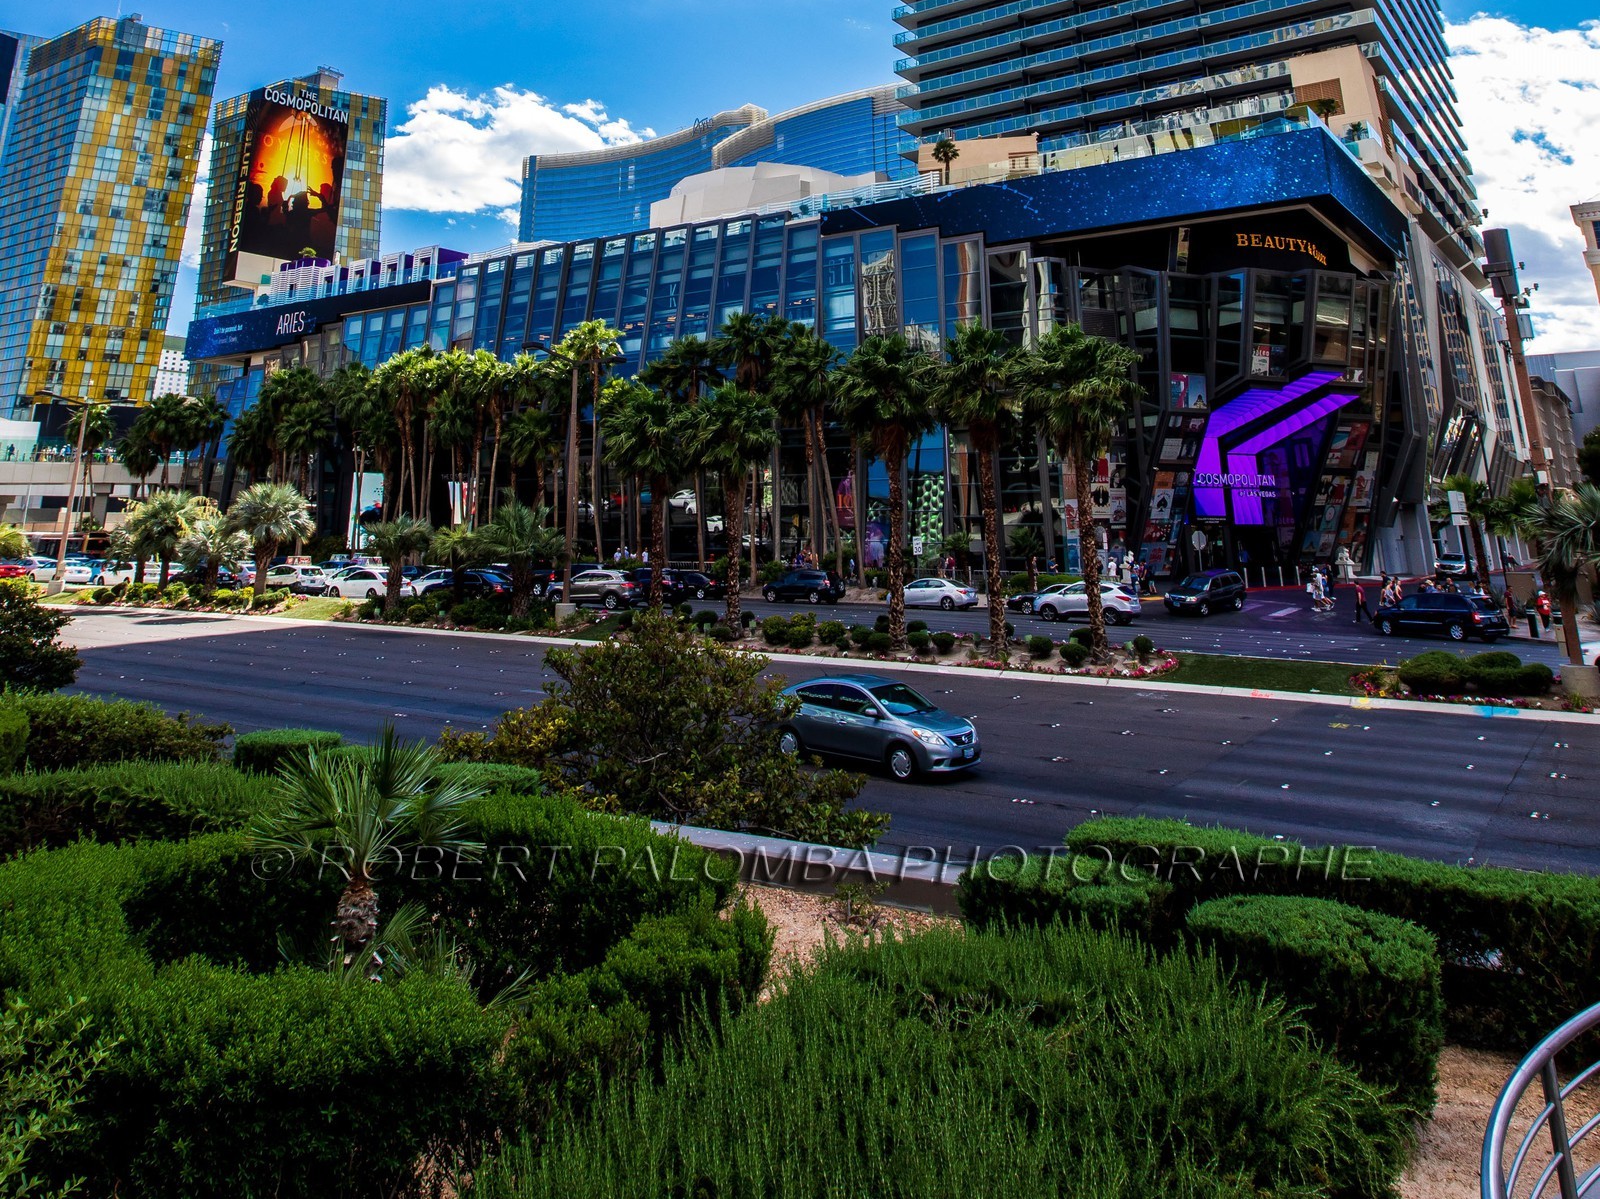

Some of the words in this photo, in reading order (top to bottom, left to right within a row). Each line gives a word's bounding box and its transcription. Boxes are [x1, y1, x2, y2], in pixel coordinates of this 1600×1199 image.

[301, 88, 318, 101] THE
[264, 88, 349, 124] COSMOPOLITAN
[229, 181, 247, 253] RIBBON
[1236, 233, 1307, 253] BEAUTY
[276, 311, 306, 336] ARIES
[1199, 473, 1276, 486] COSMOPOLITAN
[1246, 490, 1257, 498] LAS
[1258, 490, 1276, 498] VEGAS
